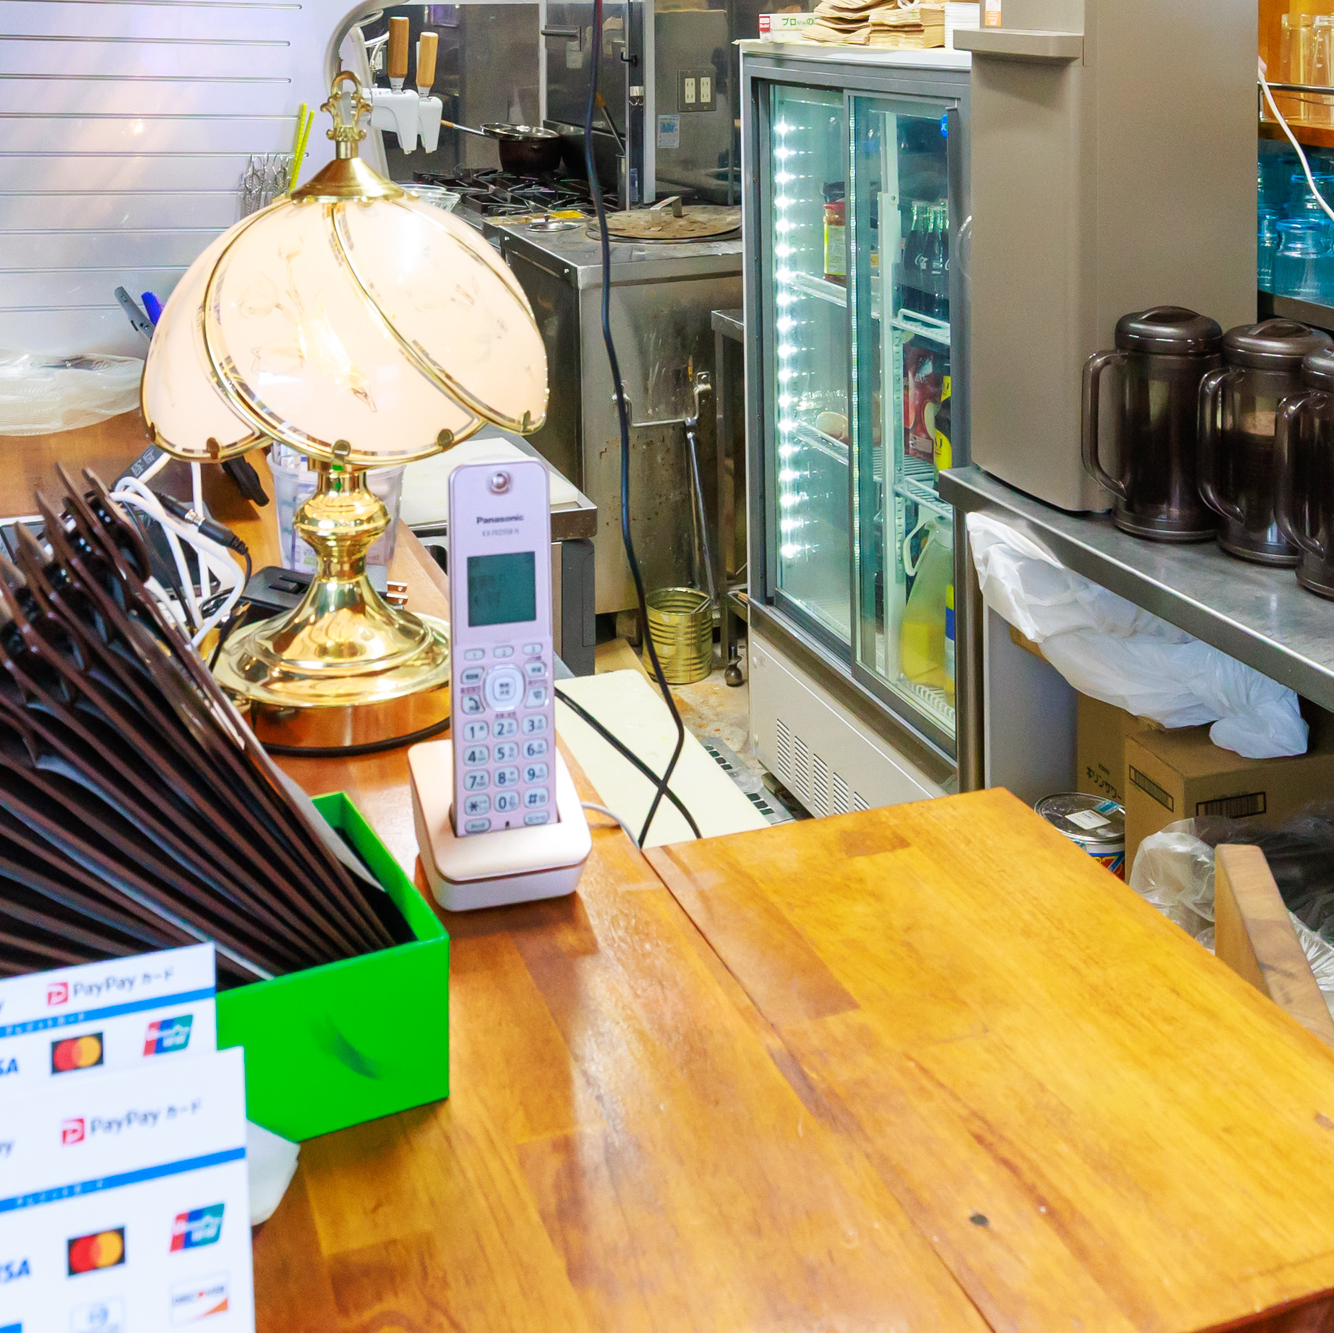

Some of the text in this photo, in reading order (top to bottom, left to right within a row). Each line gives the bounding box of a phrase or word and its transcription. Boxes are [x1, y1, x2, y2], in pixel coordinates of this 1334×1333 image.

[476, 514, 524, 525] Panasonic
[497, 723, 505, 736] 2
[528, 719, 535, 732] 3
[469, 727, 475, 739] 1
[497, 747, 505, 760] 5
[527, 744, 535, 756] 6
[467, 751, 476, 763] 4
[498, 772, 506, 785] 8
[527, 768, 536, 781] 9
[469, 775, 477, 788] 7
[499, 797, 507, 809] 0
[73, 976, 135, 999] PayPay
[90, 1106, 161, 1135] PayPay
